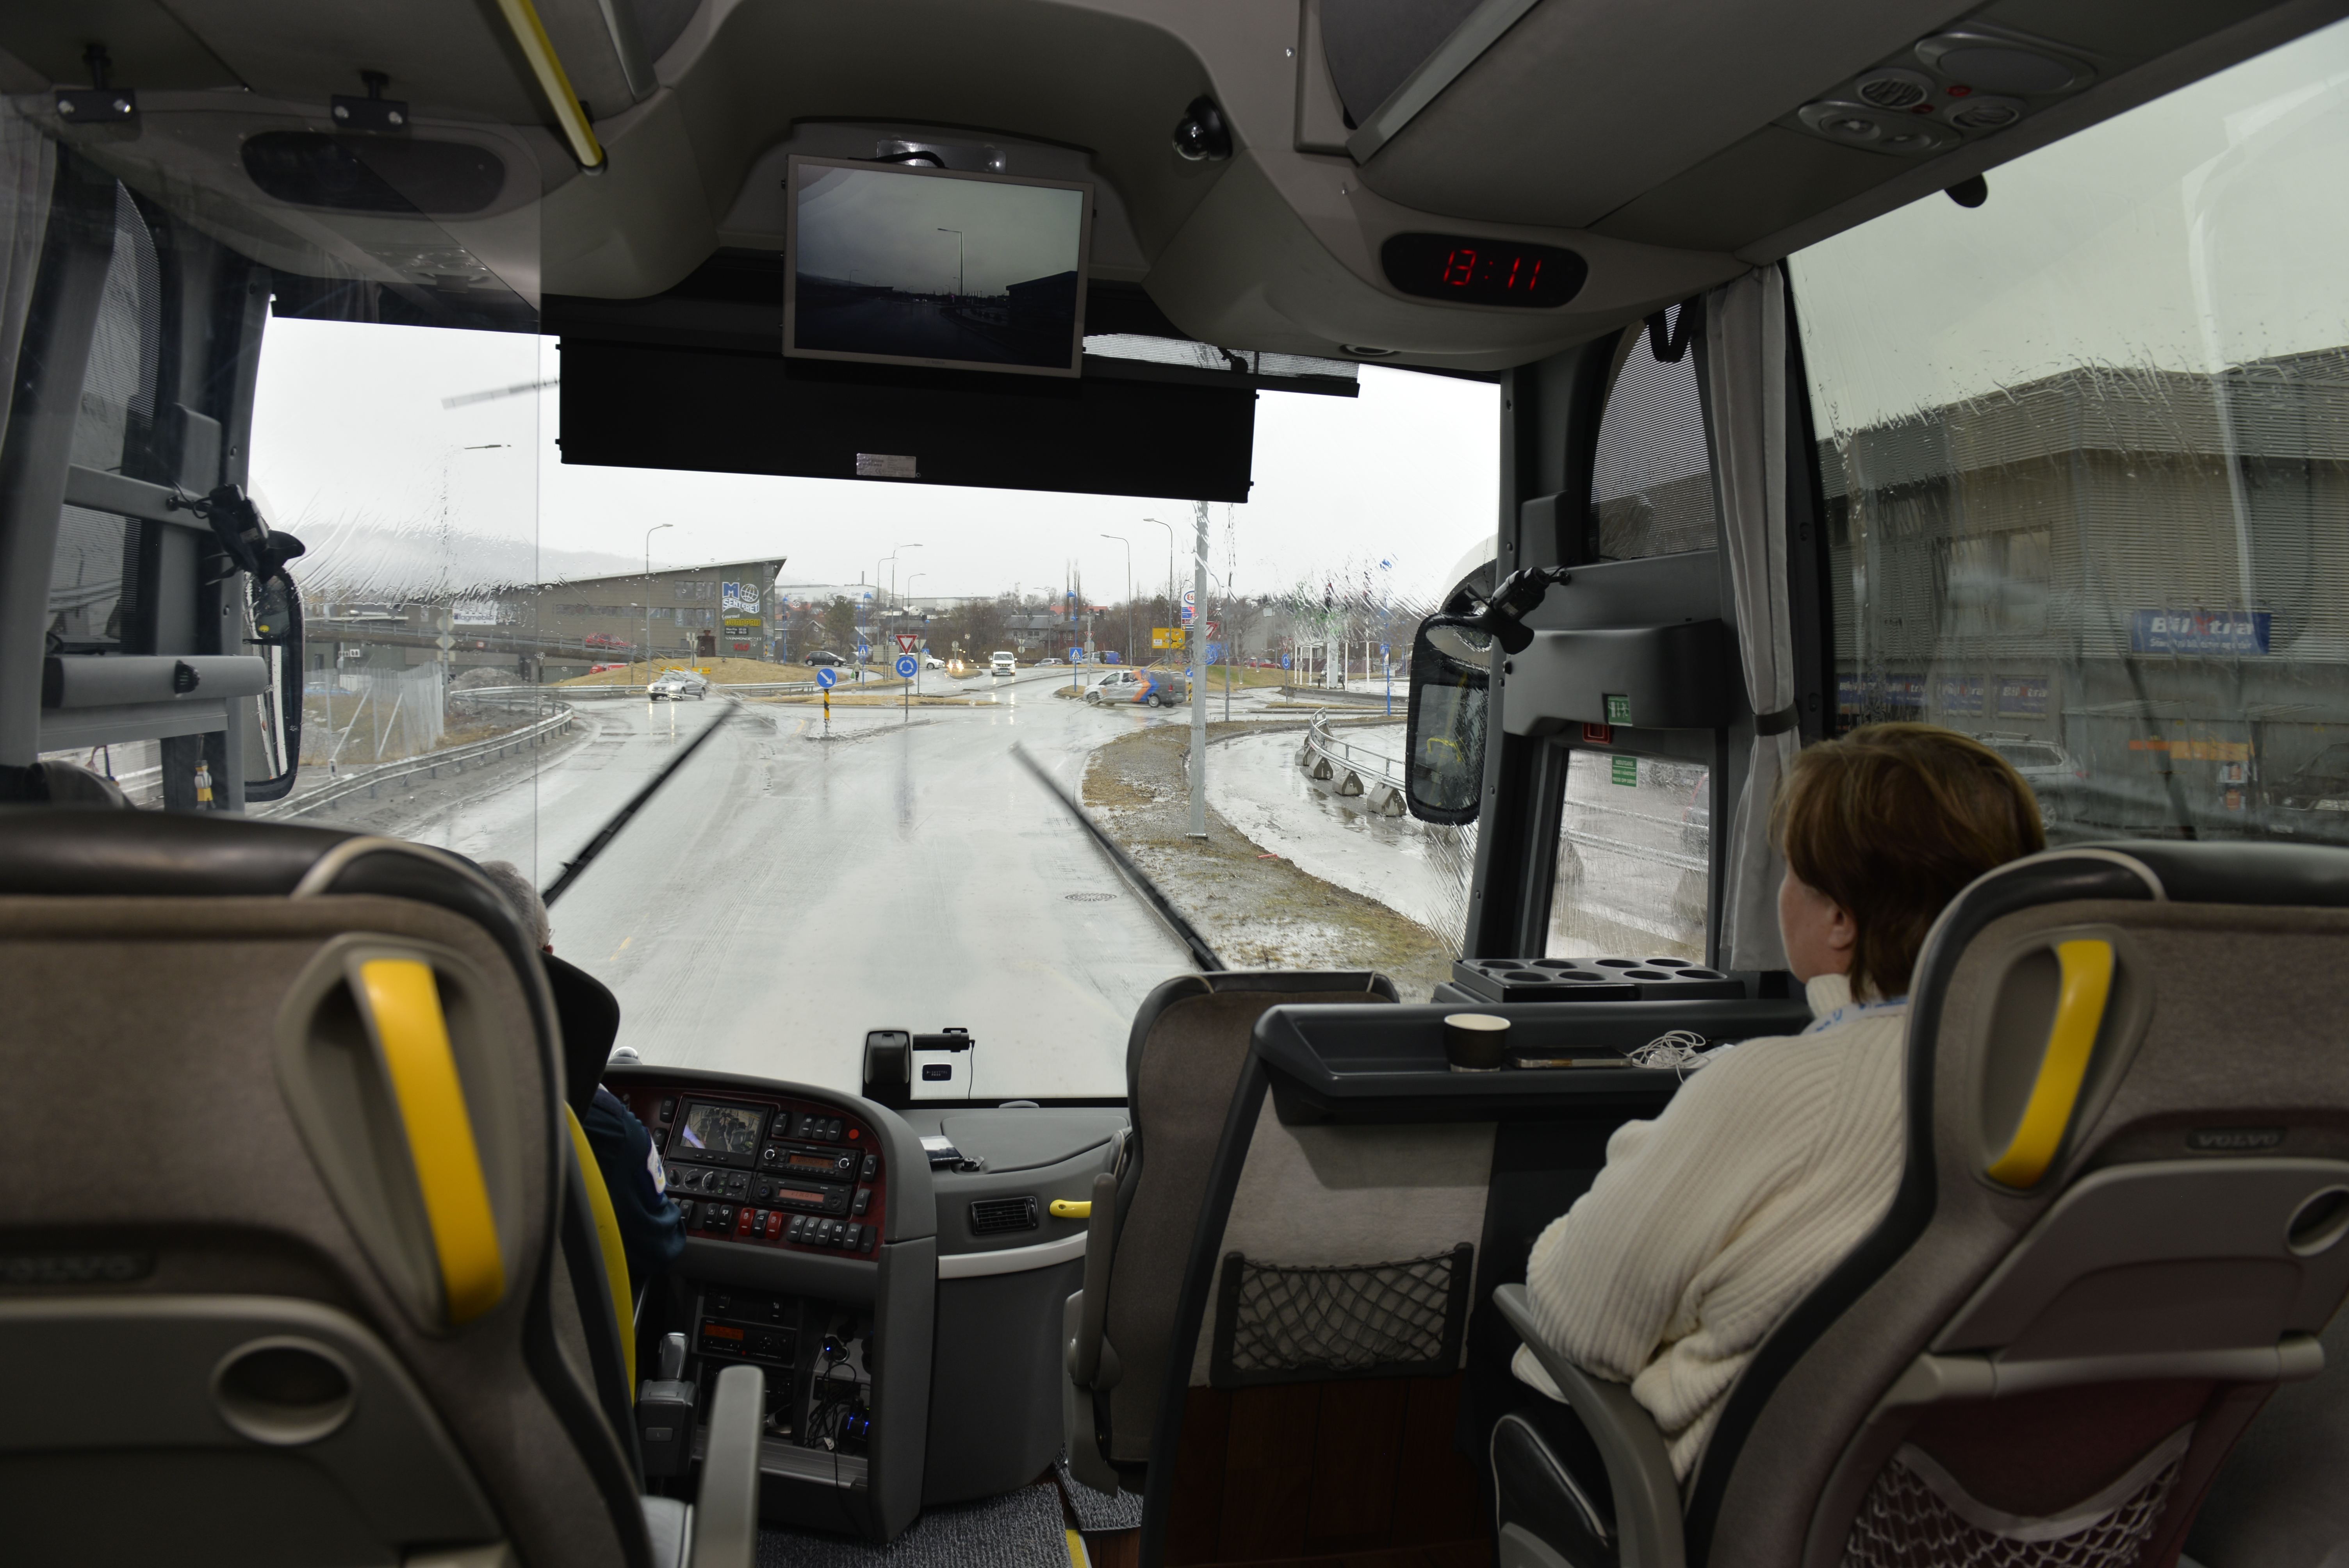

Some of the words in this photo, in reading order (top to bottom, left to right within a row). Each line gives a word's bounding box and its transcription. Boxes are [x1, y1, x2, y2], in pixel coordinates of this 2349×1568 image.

[1443, 249, 1541, 290] 13:11
[723, 598, 759, 613] SENTERET
[2150, 615, 2255, 637] BilXtra
[733, 643, 749, 651] Kid
[2003, 685, 2047, 698] BilXtra
[2197, 1133, 2279, 1147] VOLVO
